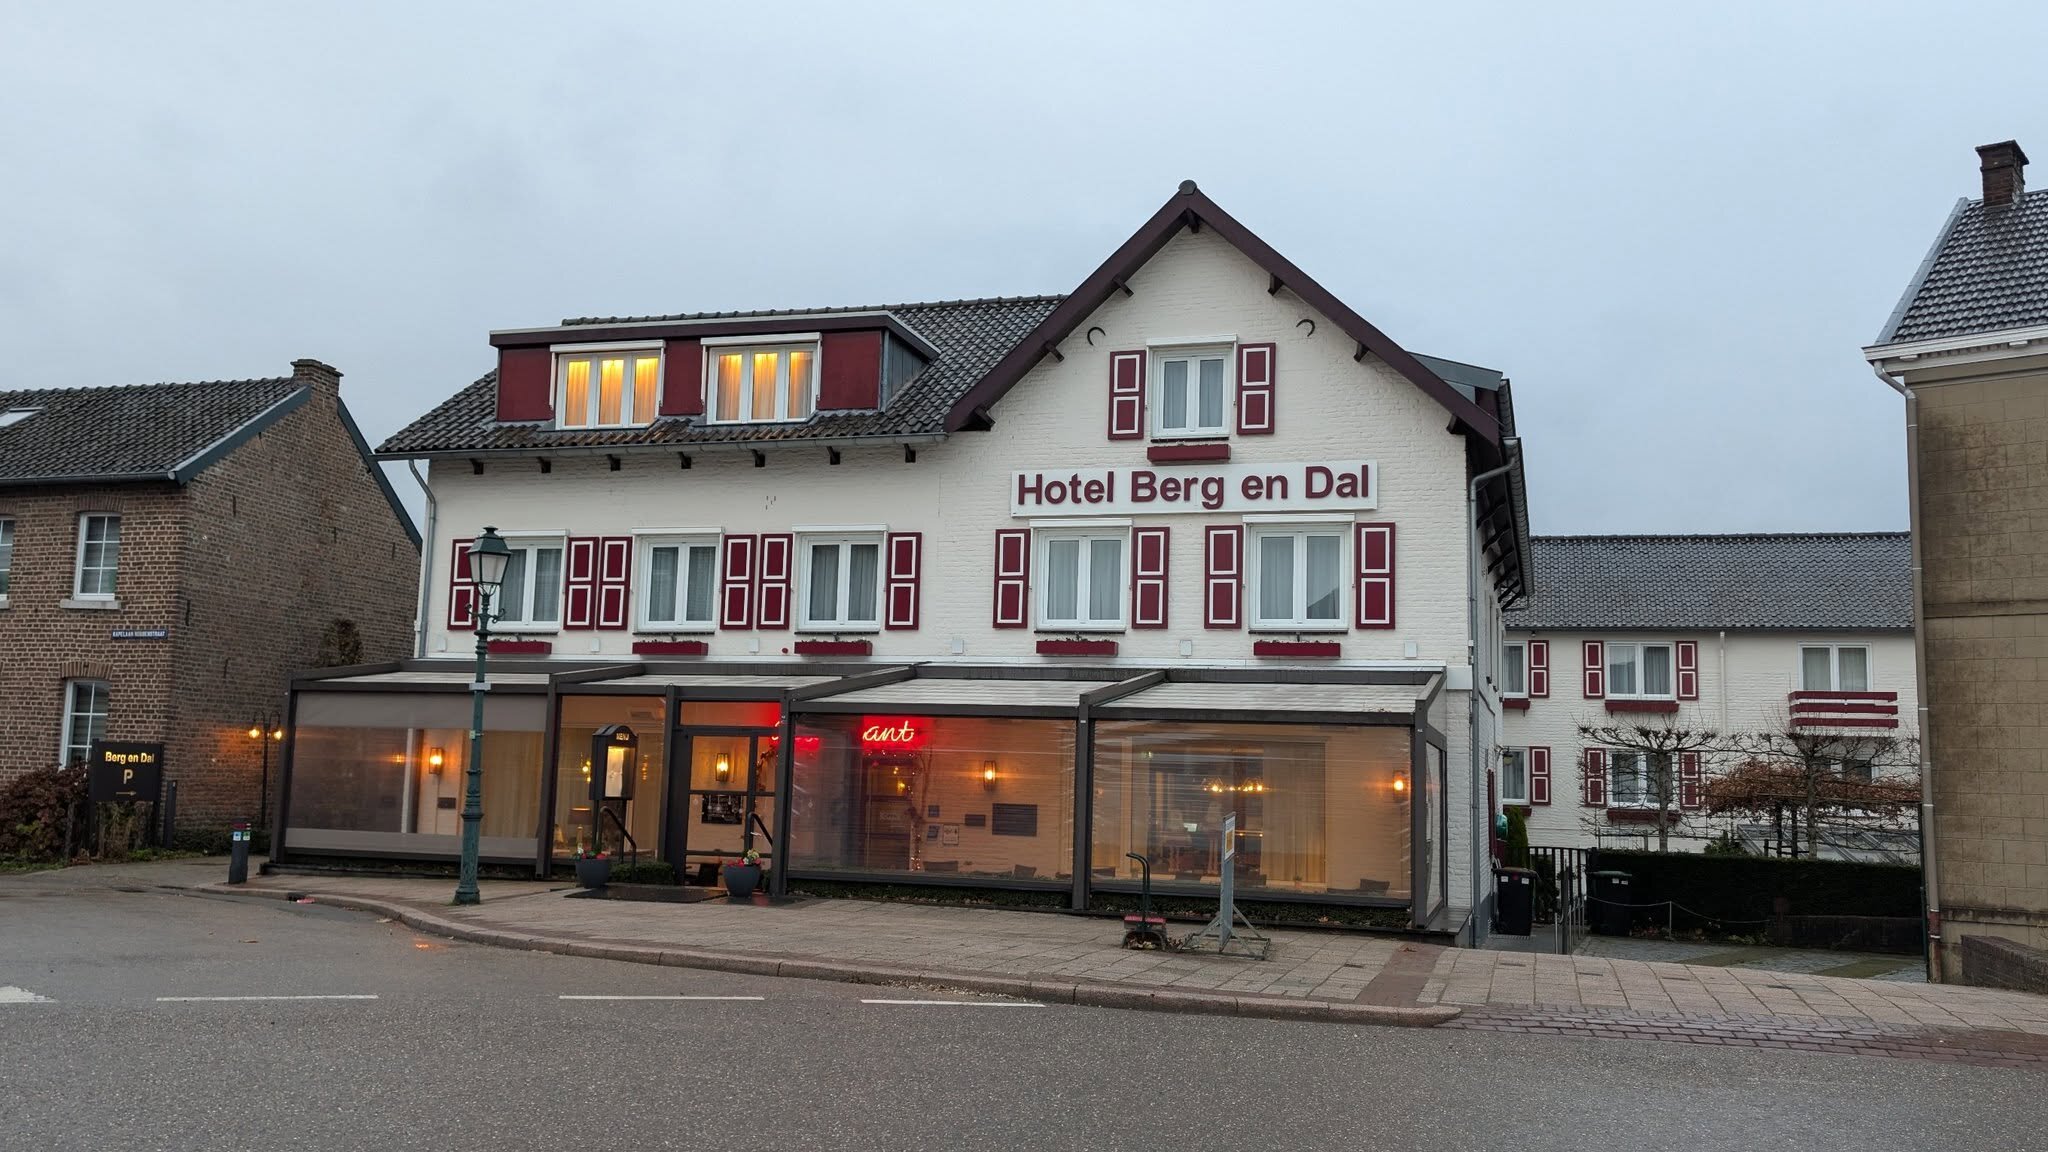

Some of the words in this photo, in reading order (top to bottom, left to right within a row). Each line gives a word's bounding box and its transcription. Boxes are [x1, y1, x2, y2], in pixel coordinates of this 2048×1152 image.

[1017, 471, 1114, 505] Hotel
[1131, 470, 1225, 510] Berg
[1241, 474, 1289, 500] en
[1305, 464, 1369, 499] Dal
[616, 732, 630, 741] MENU
[862, 720, 915, 742] ant
[105, 751, 126, 765] Berg
[128, 754, 139, 763] en
[140, 752, 155, 763] Dal
[123, 769, 133, 785] P
